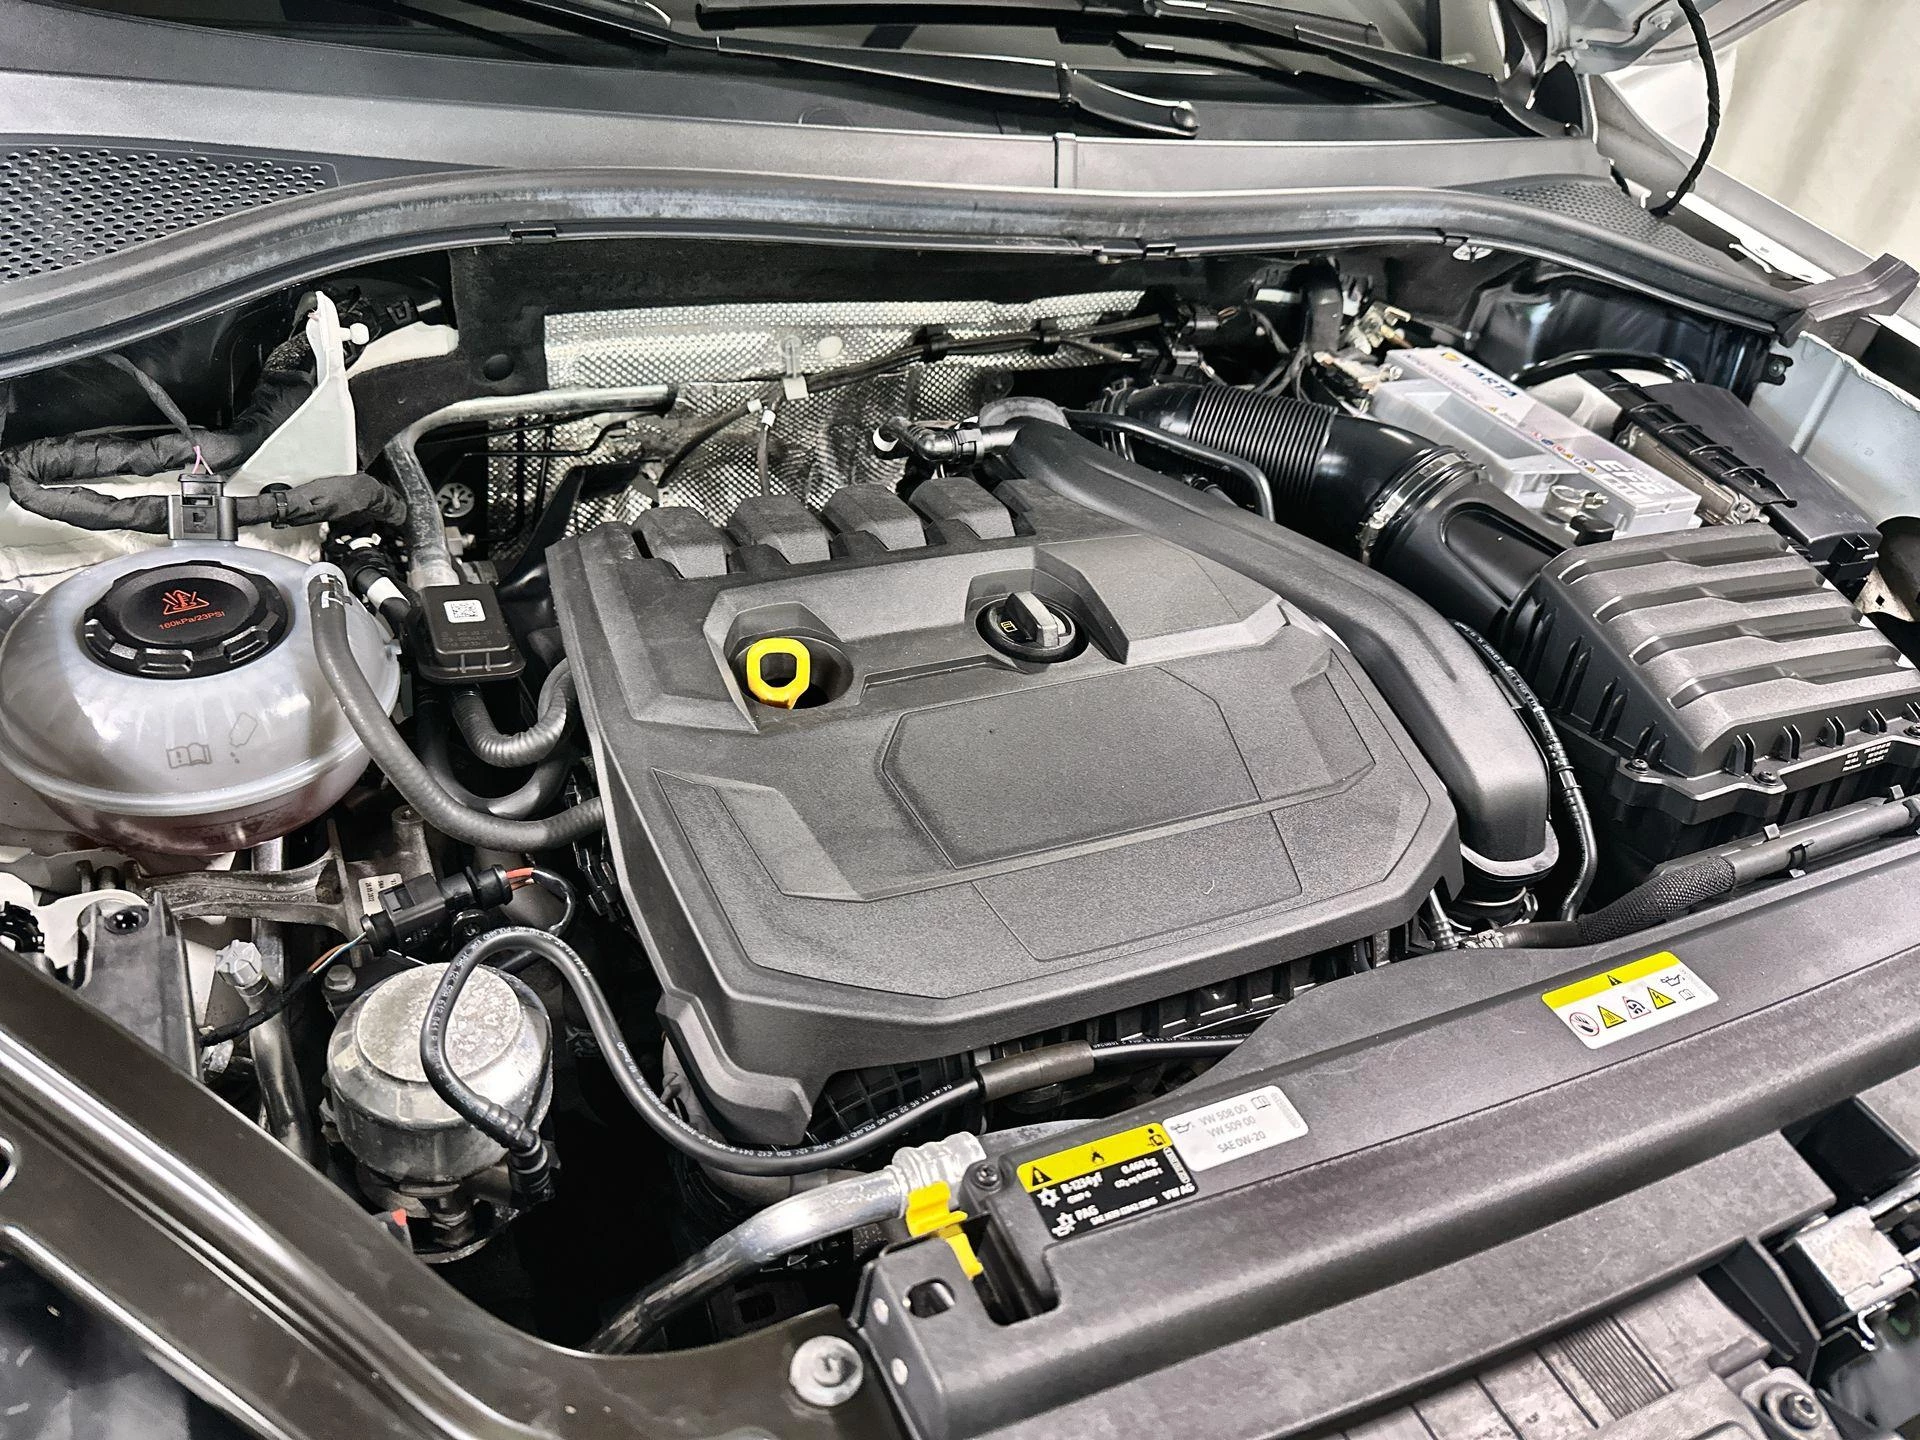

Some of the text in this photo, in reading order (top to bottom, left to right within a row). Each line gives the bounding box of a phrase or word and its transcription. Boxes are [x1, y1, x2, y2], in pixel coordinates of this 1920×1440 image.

[1460, 362, 1517, 398] VARTA
[158, 610, 226, 630] 160kPa/23PSI
[1199, 1103, 1248, 1126] VW 508 00
[1206, 1115, 1257, 1138] VW 509 00
[1217, 1130, 1267, 1153] SAE 0W-20
[1160, 1181, 1196, 1201] VW AG
[1073, 1203, 1100, 1222] PAG
